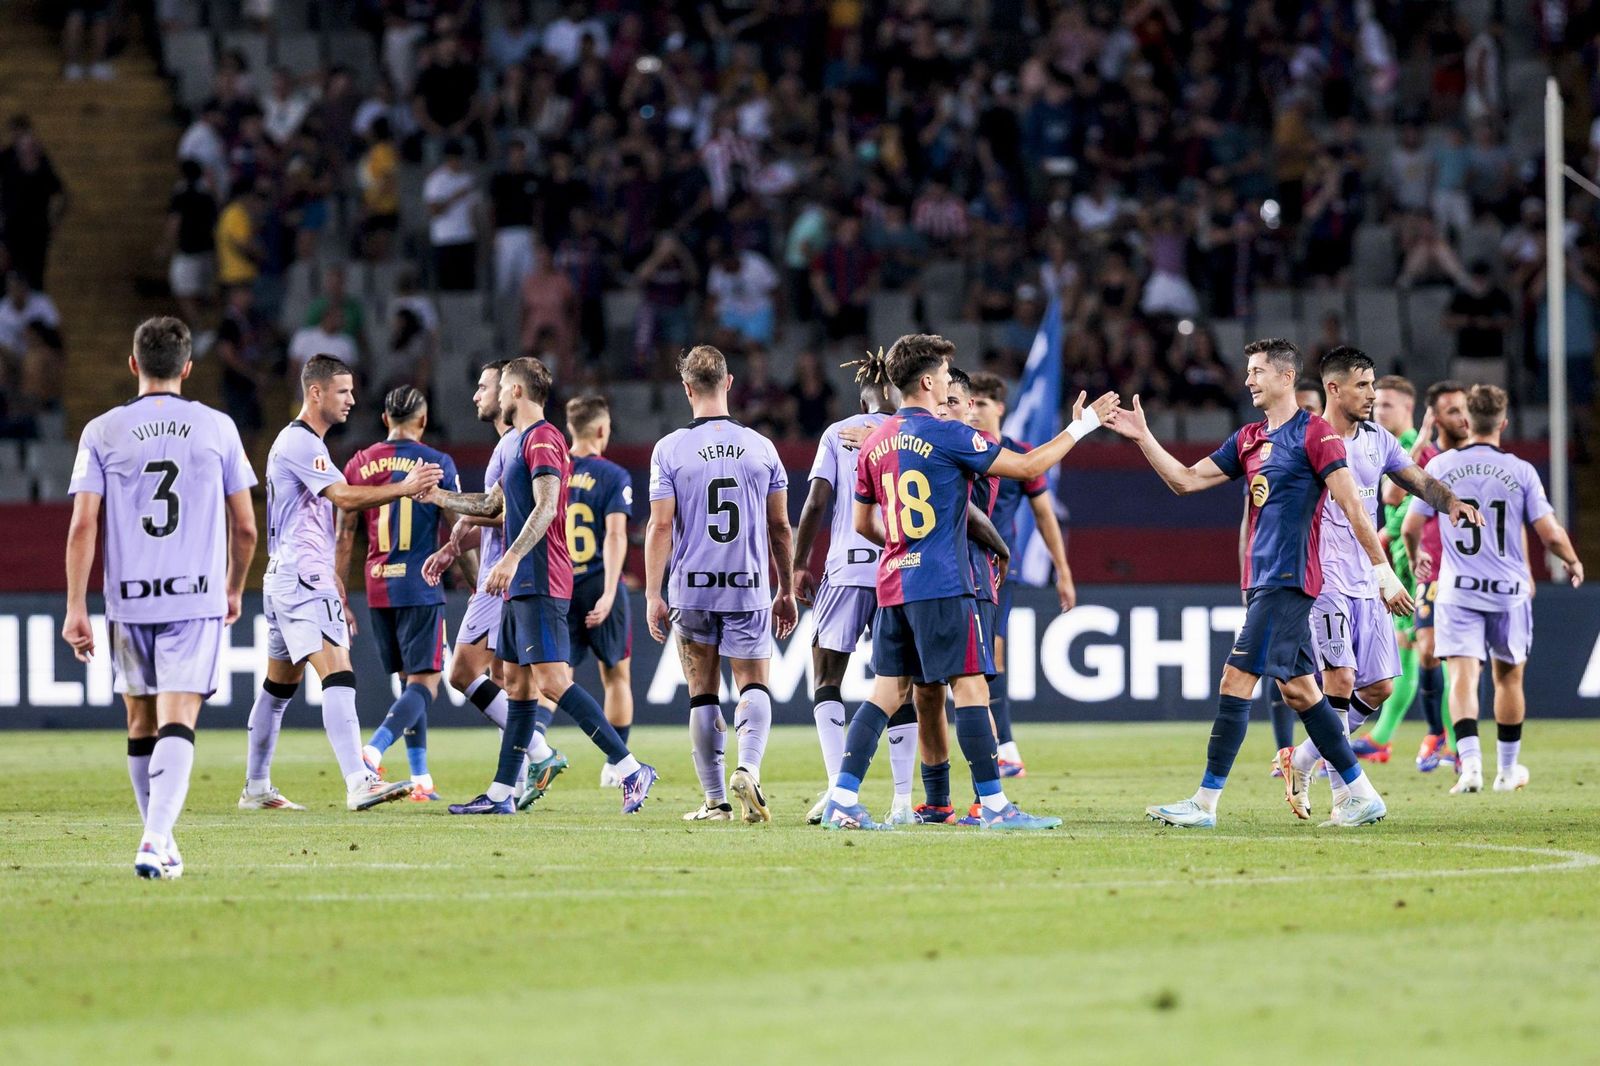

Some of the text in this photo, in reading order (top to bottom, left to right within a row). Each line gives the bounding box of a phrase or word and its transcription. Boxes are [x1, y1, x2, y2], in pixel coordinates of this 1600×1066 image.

[132, 421, 192, 441] VIVIAN
[698, 444, 746, 462] YERAY
[868, 431, 934, 467] PAU VÍCTOR
[360, 457, 416, 480] RAPHIN
[142, 460, 179, 538] 3
[707, 477, 741, 544] 5
[881, 469, 936, 543] 18
[377, 495, 412, 553] 11
[565, 502, 597, 563] 6
[1455, 498, 1507, 558] 31
[119, 574, 209, 600] DIGI
[687, 571, 760, 589] DIGI
[1454, 575, 1521, 596] DIGI
[322, 598, 345, 623] 12
[1322, 612, 1346, 640] 17
[646, 605, 1263, 704] AMBIGHT
